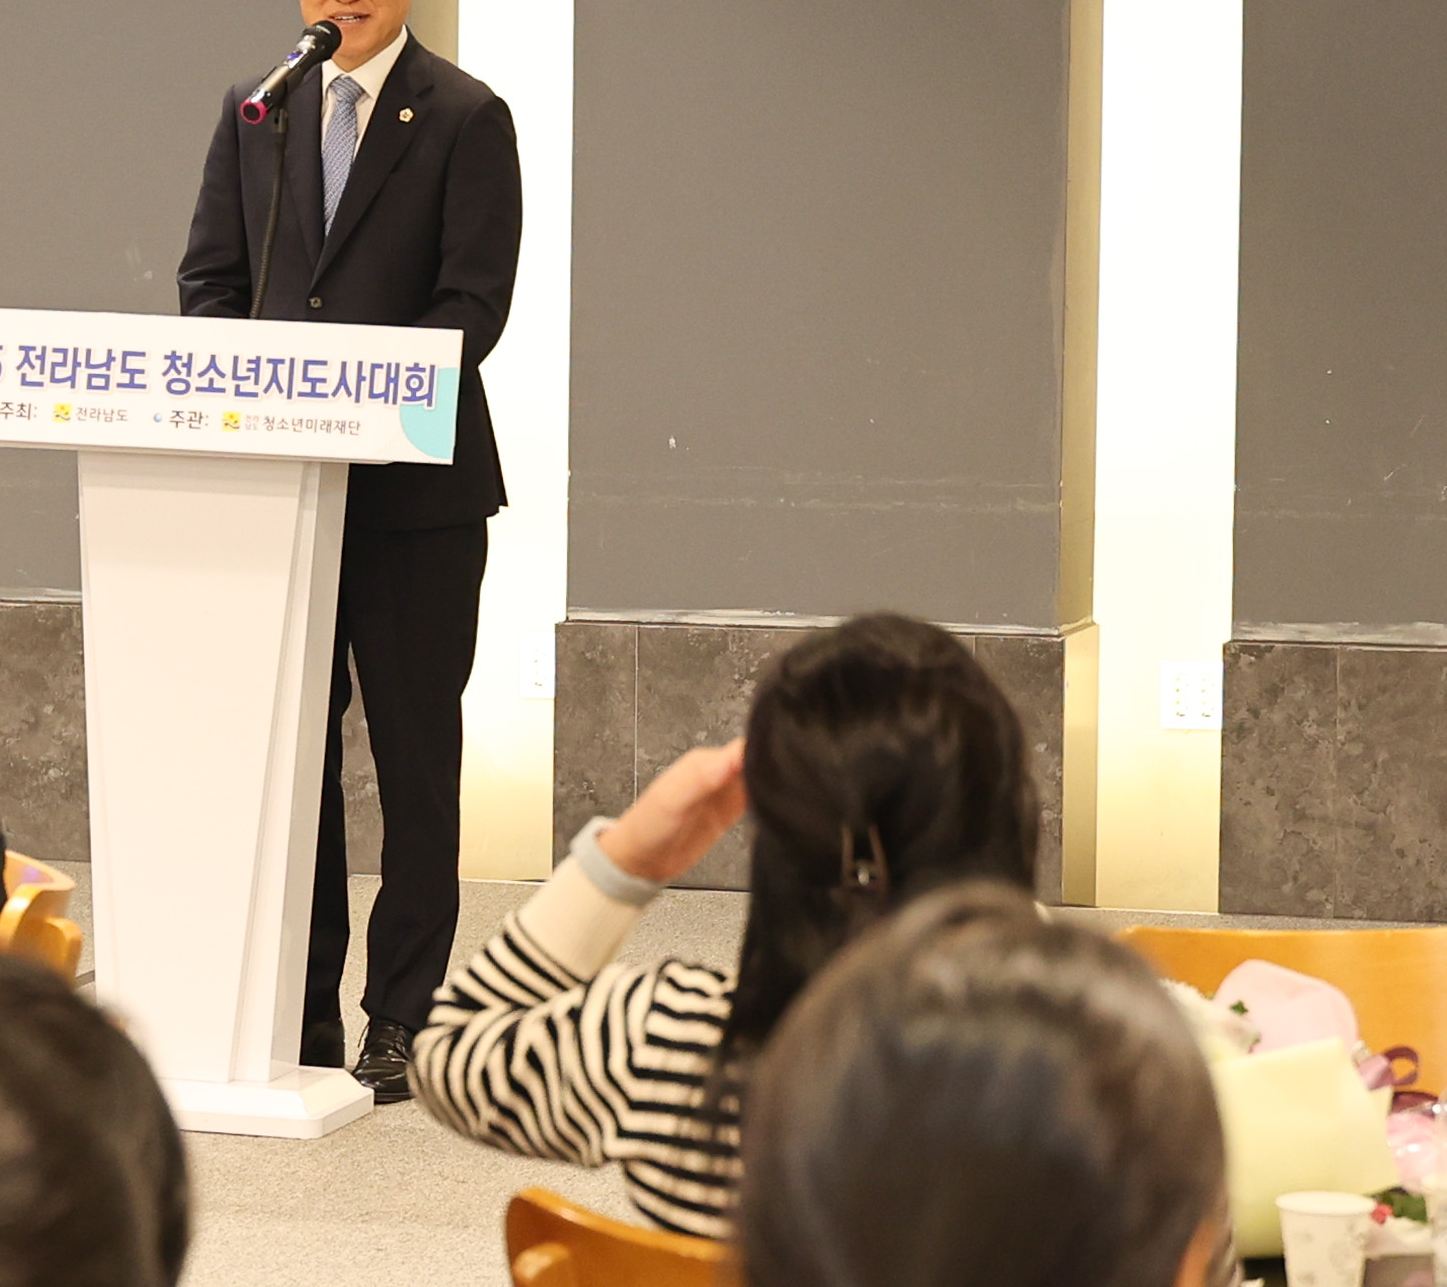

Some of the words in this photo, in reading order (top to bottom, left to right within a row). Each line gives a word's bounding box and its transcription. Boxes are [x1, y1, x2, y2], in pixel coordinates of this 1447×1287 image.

[16, 345, 147, 391] 전라남도
[161, 349, 436, 407] 청소년지도사대회
[0, 401, 38, 420] 주최:
[76, 406, 129, 423] 전라남도
[169, 409, 209, 430] 주관:
[263, 416, 361, 436] 청소년미래재단
